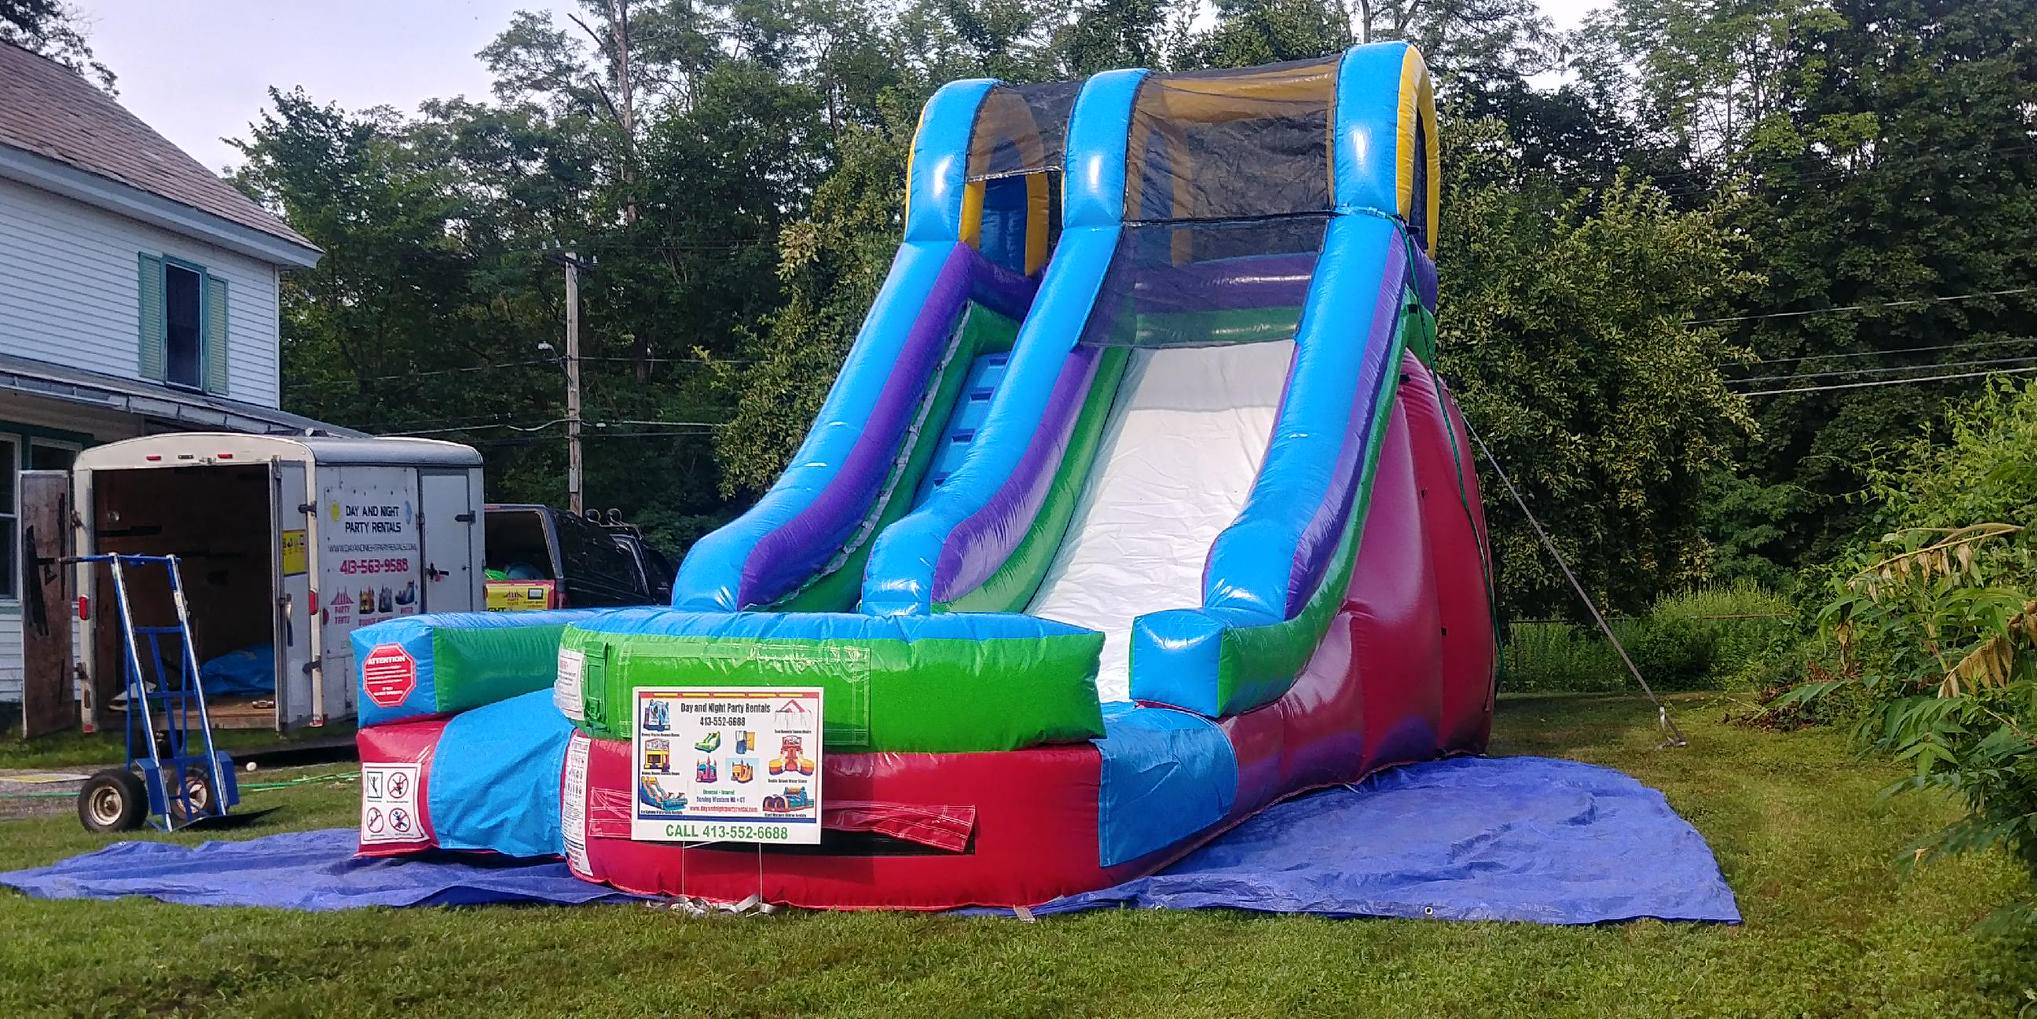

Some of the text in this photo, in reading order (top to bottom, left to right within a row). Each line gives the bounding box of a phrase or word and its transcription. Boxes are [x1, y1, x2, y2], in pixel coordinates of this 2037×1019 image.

[345, 505, 400, 517] DAY AND NIGHT
[345, 522, 402, 534] PARTY RENTALS
[368, 655, 406, 665] ATTENTION
[680, 702, 771, 714] Day and Night Party Rentals
[700, 716, 746, 726] 413-552-6688
[665, 824, 789, 839] CALL 413-552-6688
